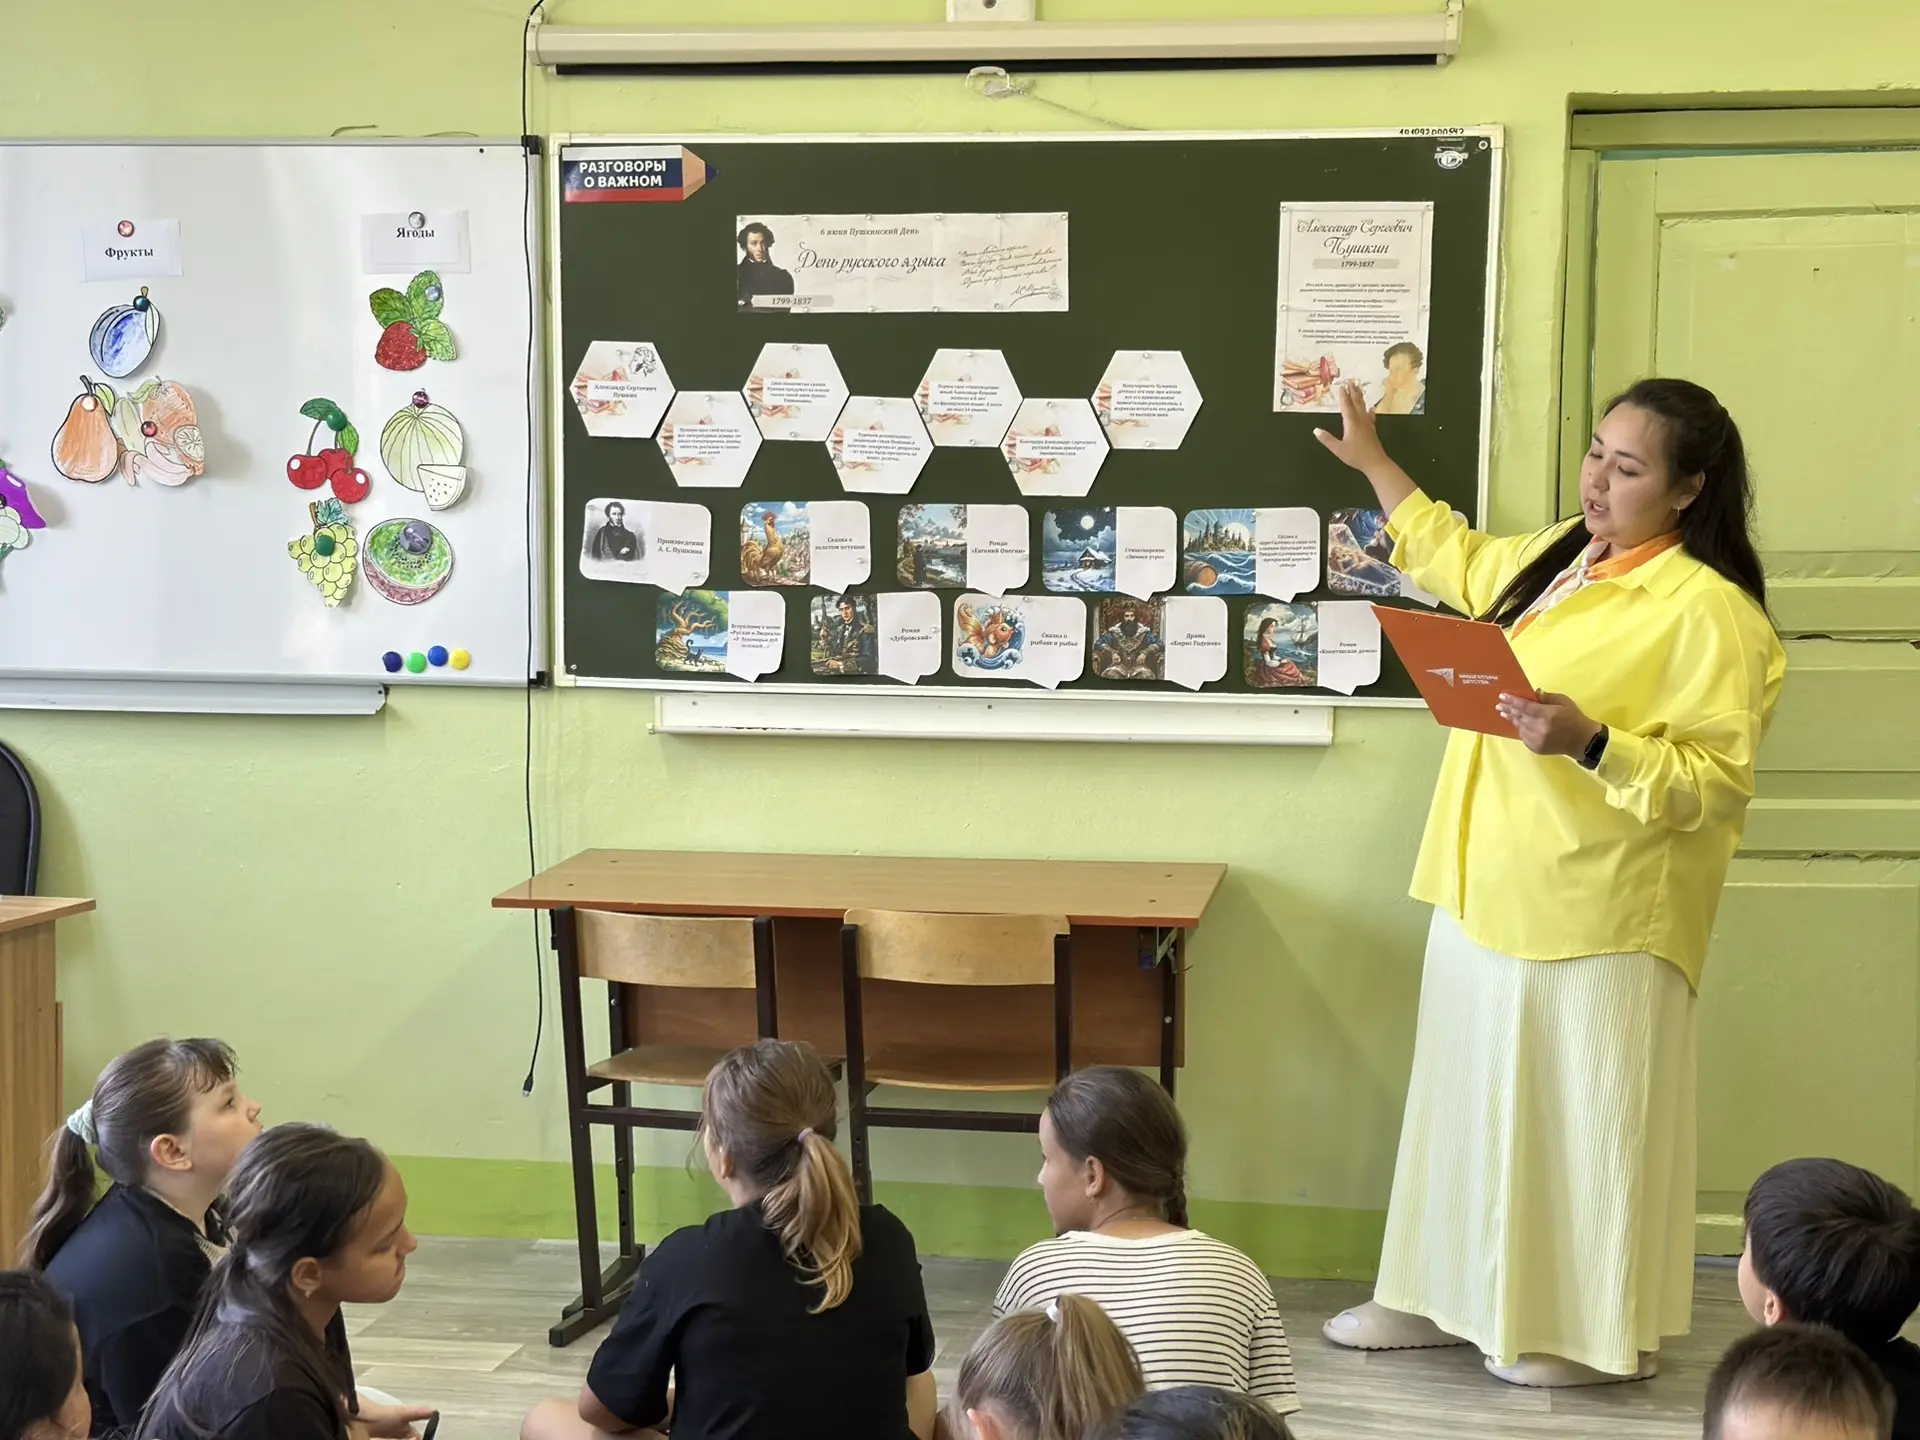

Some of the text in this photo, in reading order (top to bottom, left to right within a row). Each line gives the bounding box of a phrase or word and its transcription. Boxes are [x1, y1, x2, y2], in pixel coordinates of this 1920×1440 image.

[580, 160, 667, 173] РАЗГОВОРЫ
[584, 175, 663, 188] О ВАЖНОМ
[396, 227, 435, 239] Ягоды
[820, 227, 920, 237] 6 июня Пушкинский День
[1297, 218, 1413, 236] Александр Сергеевич
[104, 247, 154, 260] Фрукты
[1323, 236, 1389, 259] Пушкин
[794, 242, 839, 273] День
[836, 258, 899, 274] русского
[901, 257, 946, 274] языка
[772, 297, 812, 305] 1799-1837
[657, 537, 704, 546] Произведения
[672, 546, 703, 555] Пушкина
[1186, 632, 1206, 640] Драма
